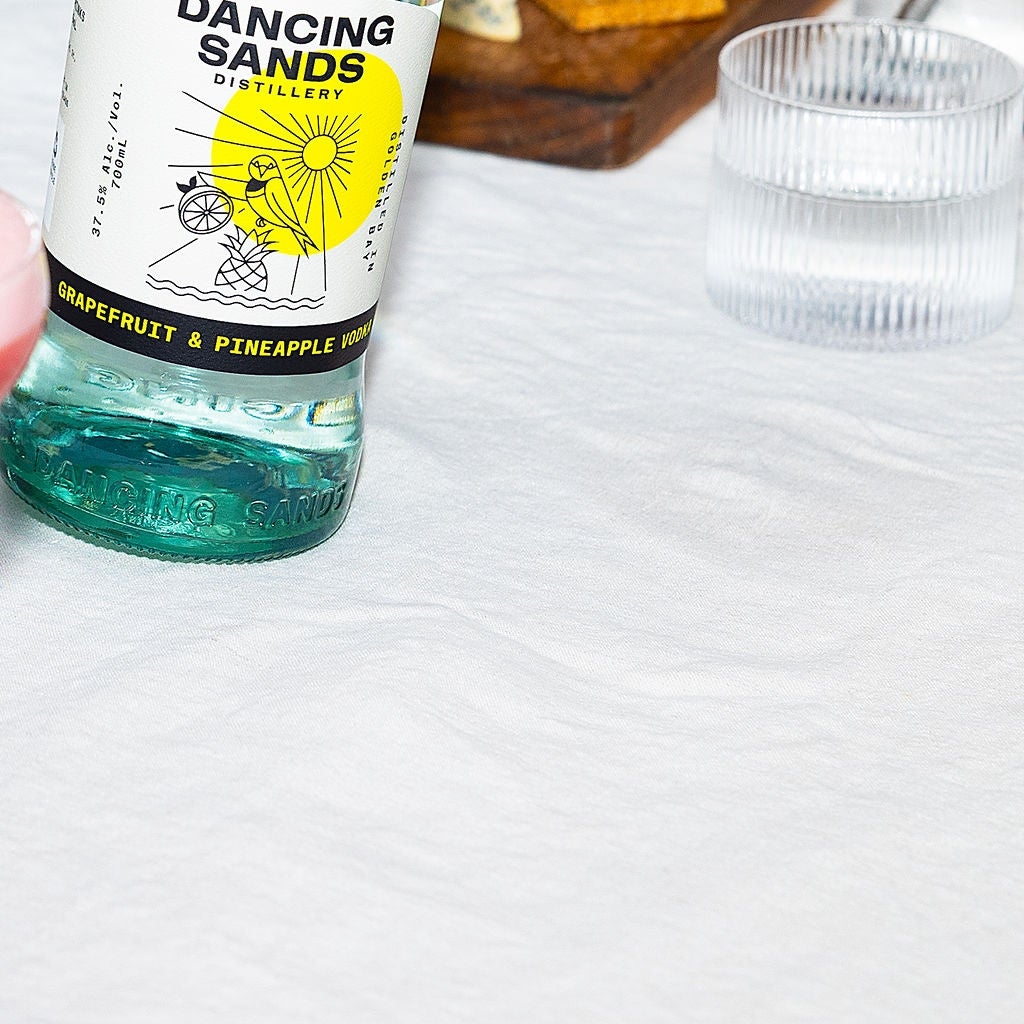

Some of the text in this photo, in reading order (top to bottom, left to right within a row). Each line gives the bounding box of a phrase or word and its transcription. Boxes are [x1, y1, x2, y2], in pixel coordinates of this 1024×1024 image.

[197, 33, 366, 84] SANDS
[213, 73, 345, 100] DISTILLERY
[91, 83, 123, 238] 37.5% Alc./Vol.
[111, 139, 128, 190] 700mL
[362, 131, 398, 261] GOLDEN BAY
[377, 114, 409, 232] DISTILLED
[57, 280, 178, 344] GRAPEFRUIT
[187, 331, 203, 349] &
[214, 336, 336, 358] PINEAPPLE
[33, 444, 217, 528] DANCING
